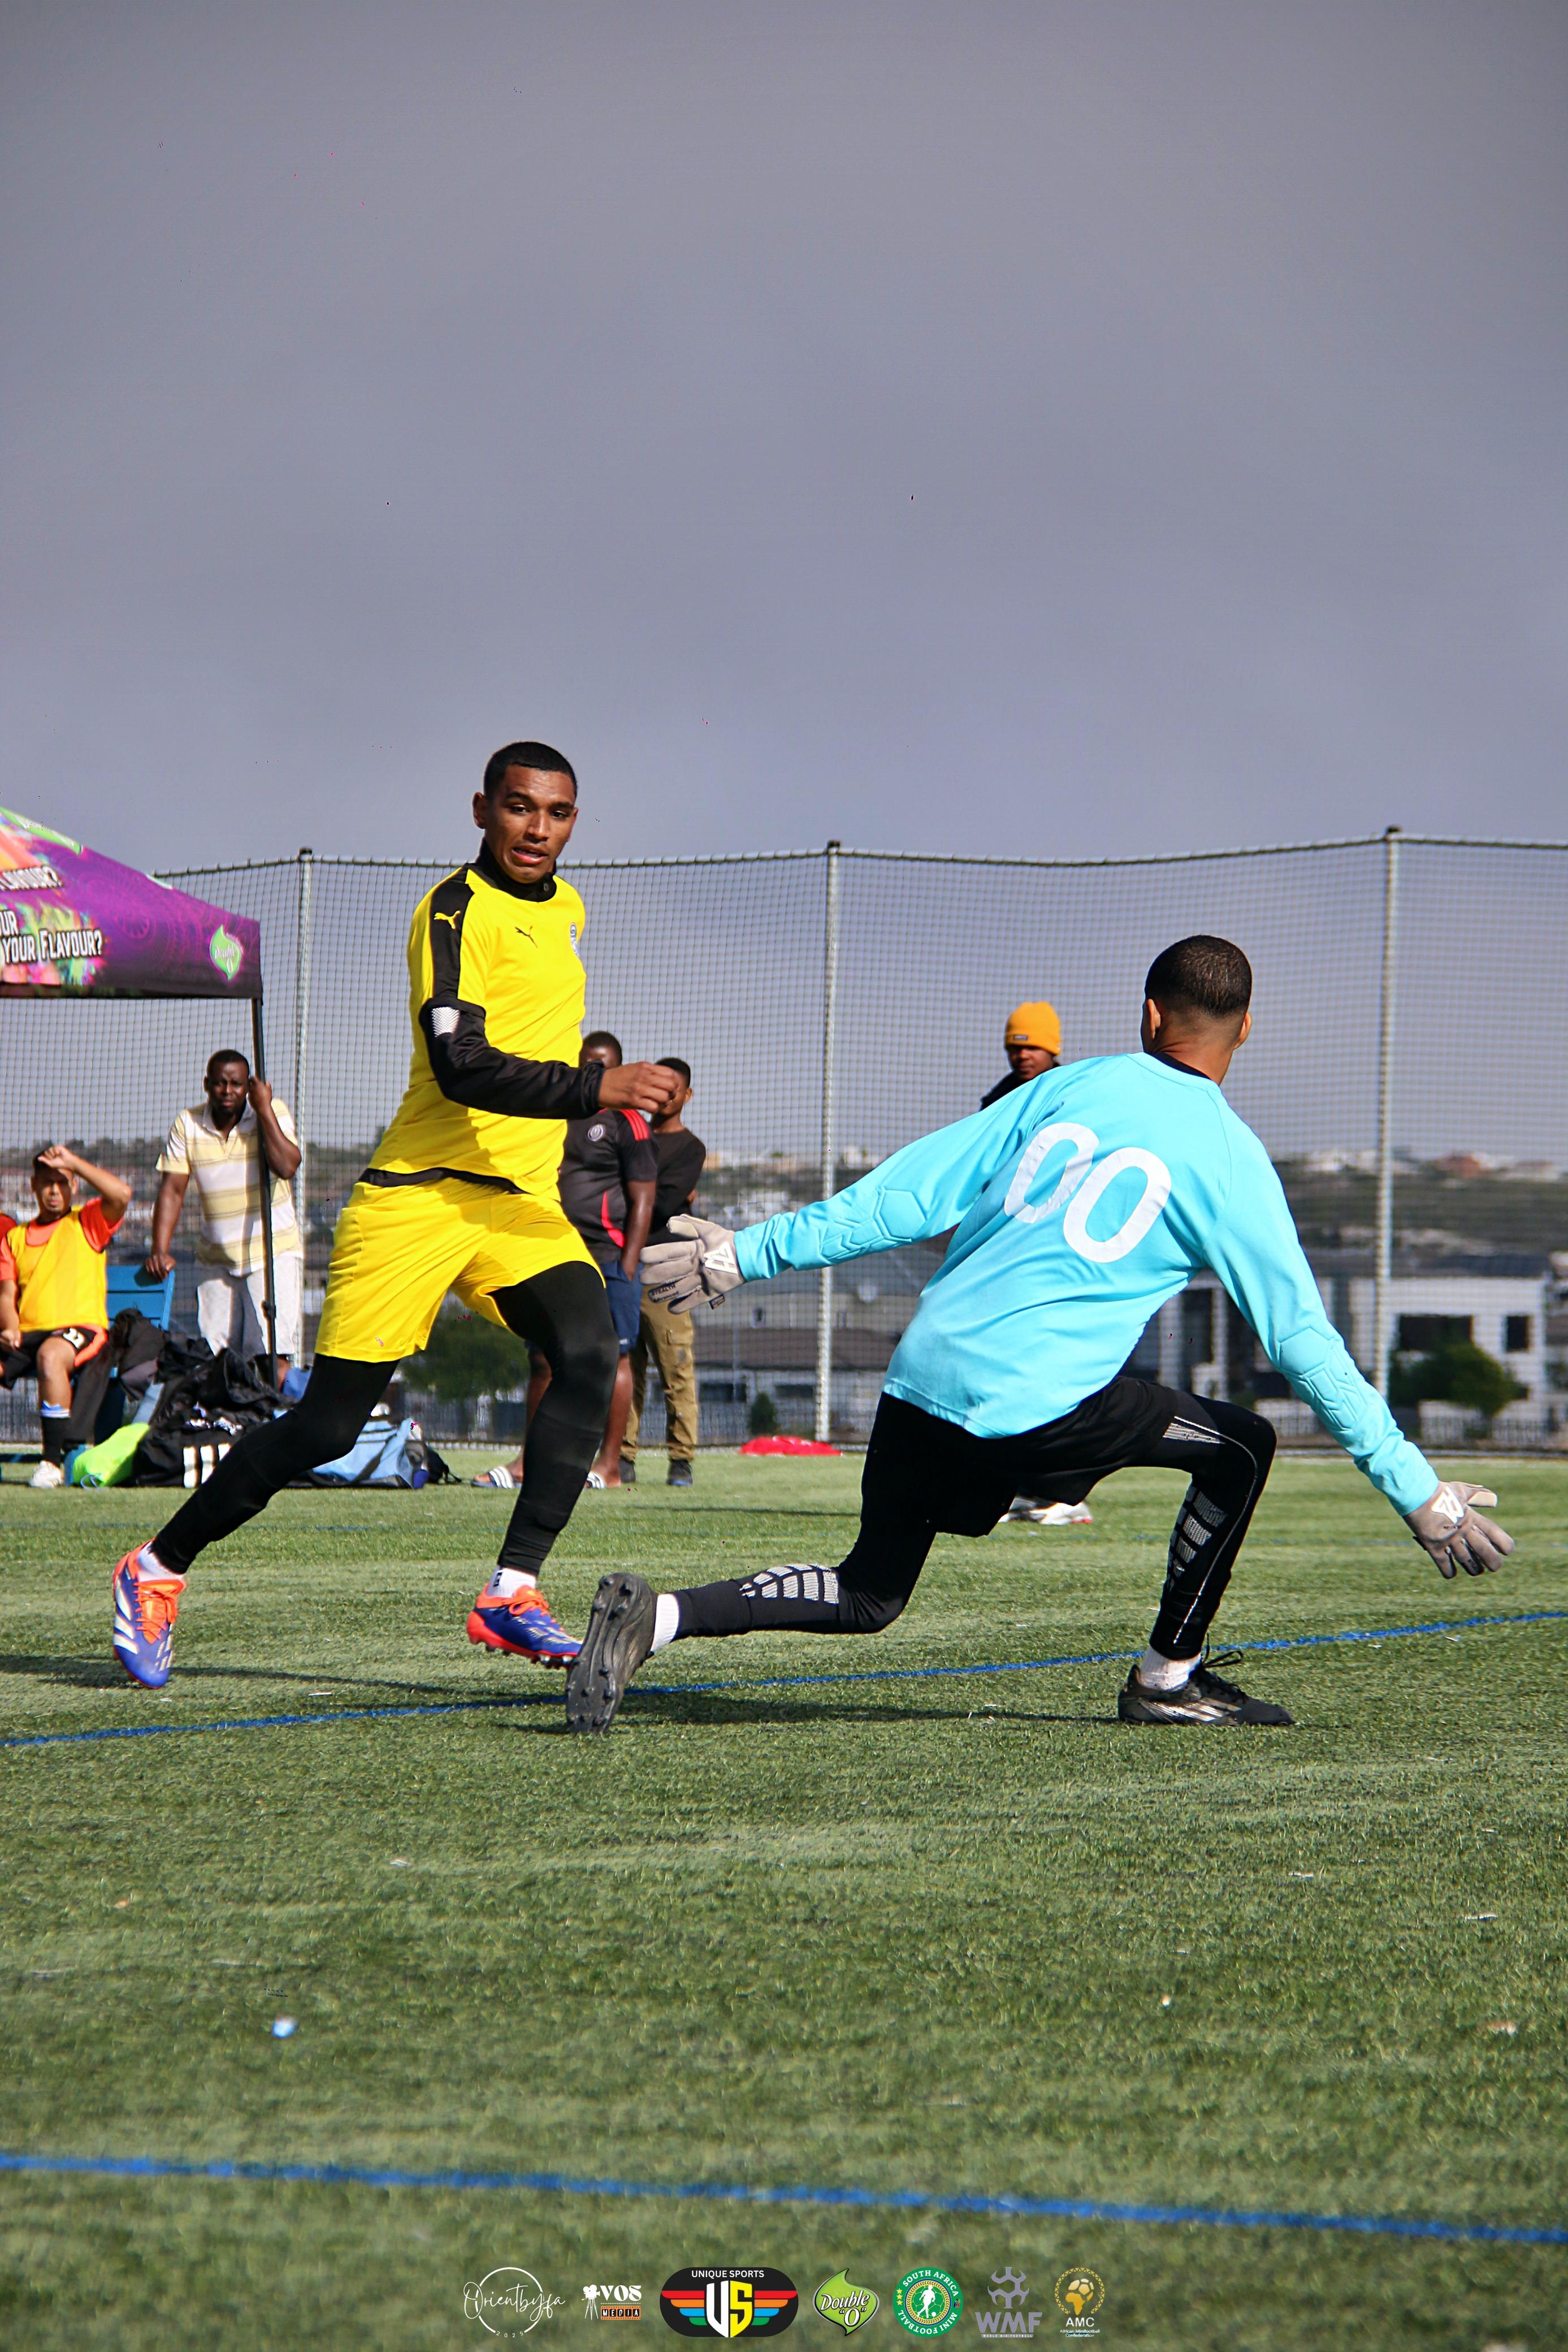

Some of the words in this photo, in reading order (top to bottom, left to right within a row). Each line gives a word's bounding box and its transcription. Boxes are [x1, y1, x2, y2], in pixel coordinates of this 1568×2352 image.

[2, 935, 37, 964] YOUR
[39, 929, 103, 961] FLAVOUR?
[1004, 1122, 1172, 1264] 00
[651, 1283, 677, 1296] STEALTH
